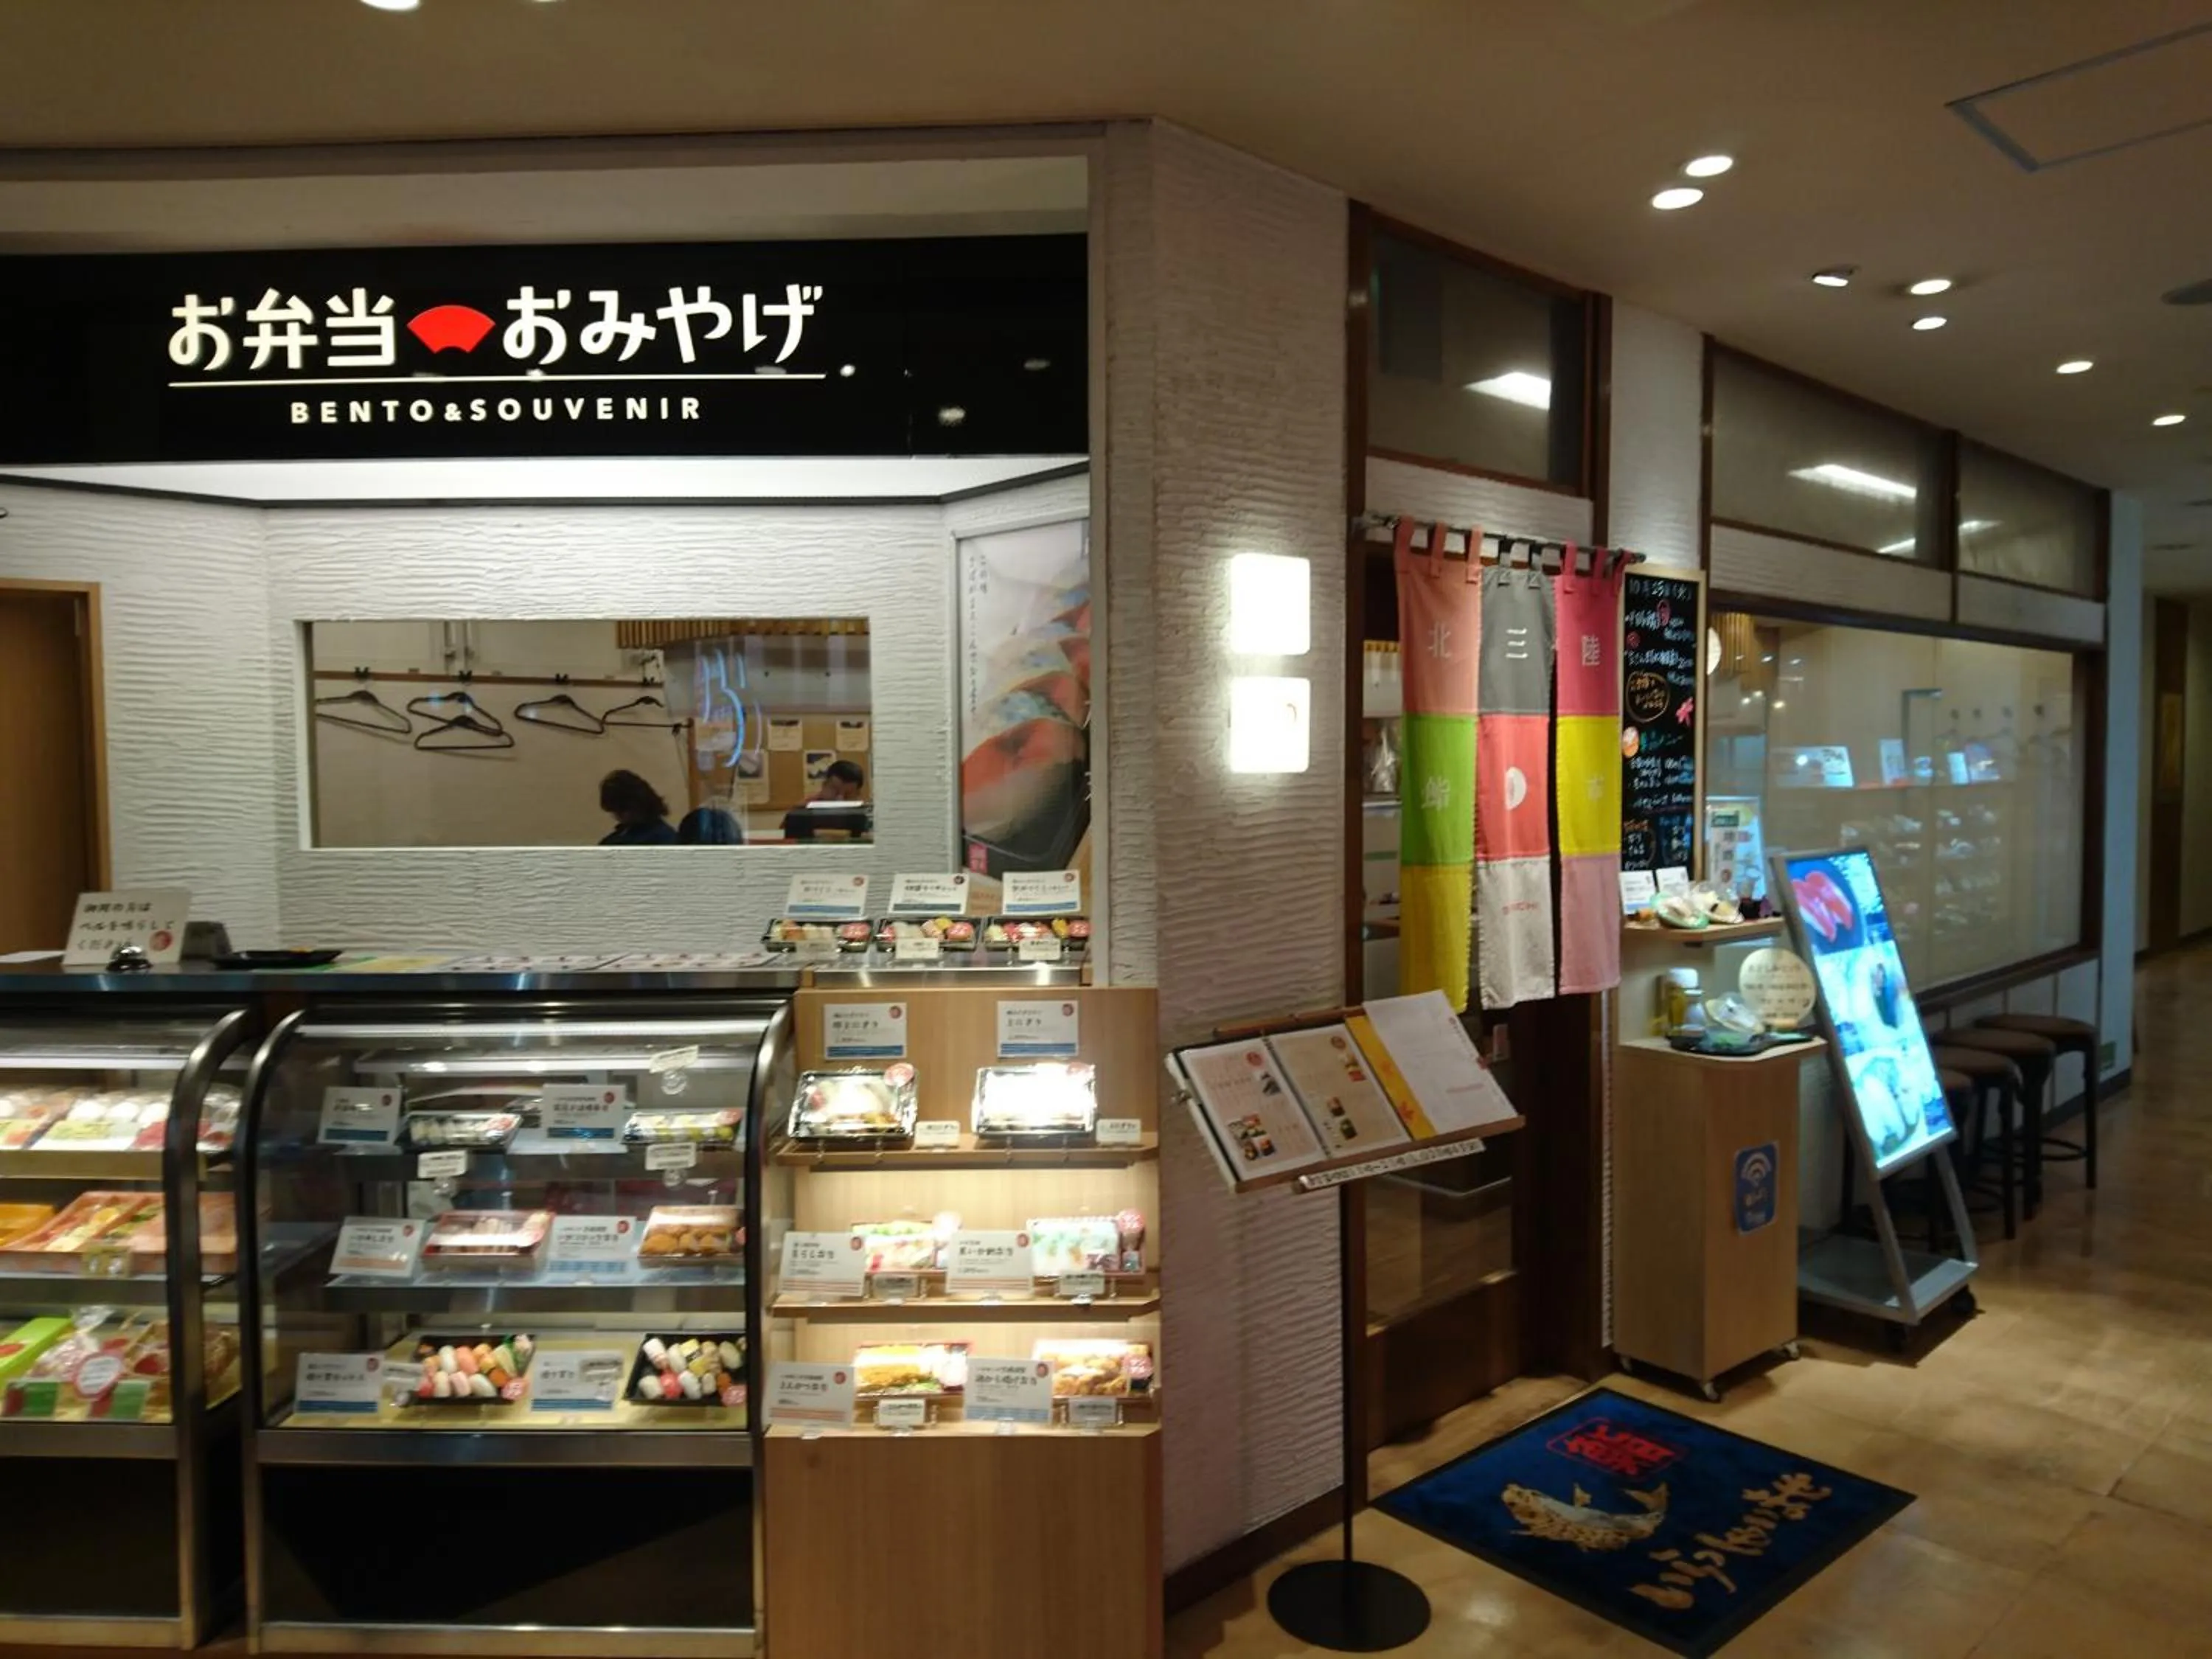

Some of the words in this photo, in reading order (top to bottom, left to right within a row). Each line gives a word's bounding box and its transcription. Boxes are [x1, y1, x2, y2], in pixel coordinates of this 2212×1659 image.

[168, 287, 395, 370] お弁当
[503, 283, 824, 366] おみやげ
[290, 396, 701, 425] BENTO&SOUVENIR
[1629, 1472, 1833, 1610] いらっしゃいませ
